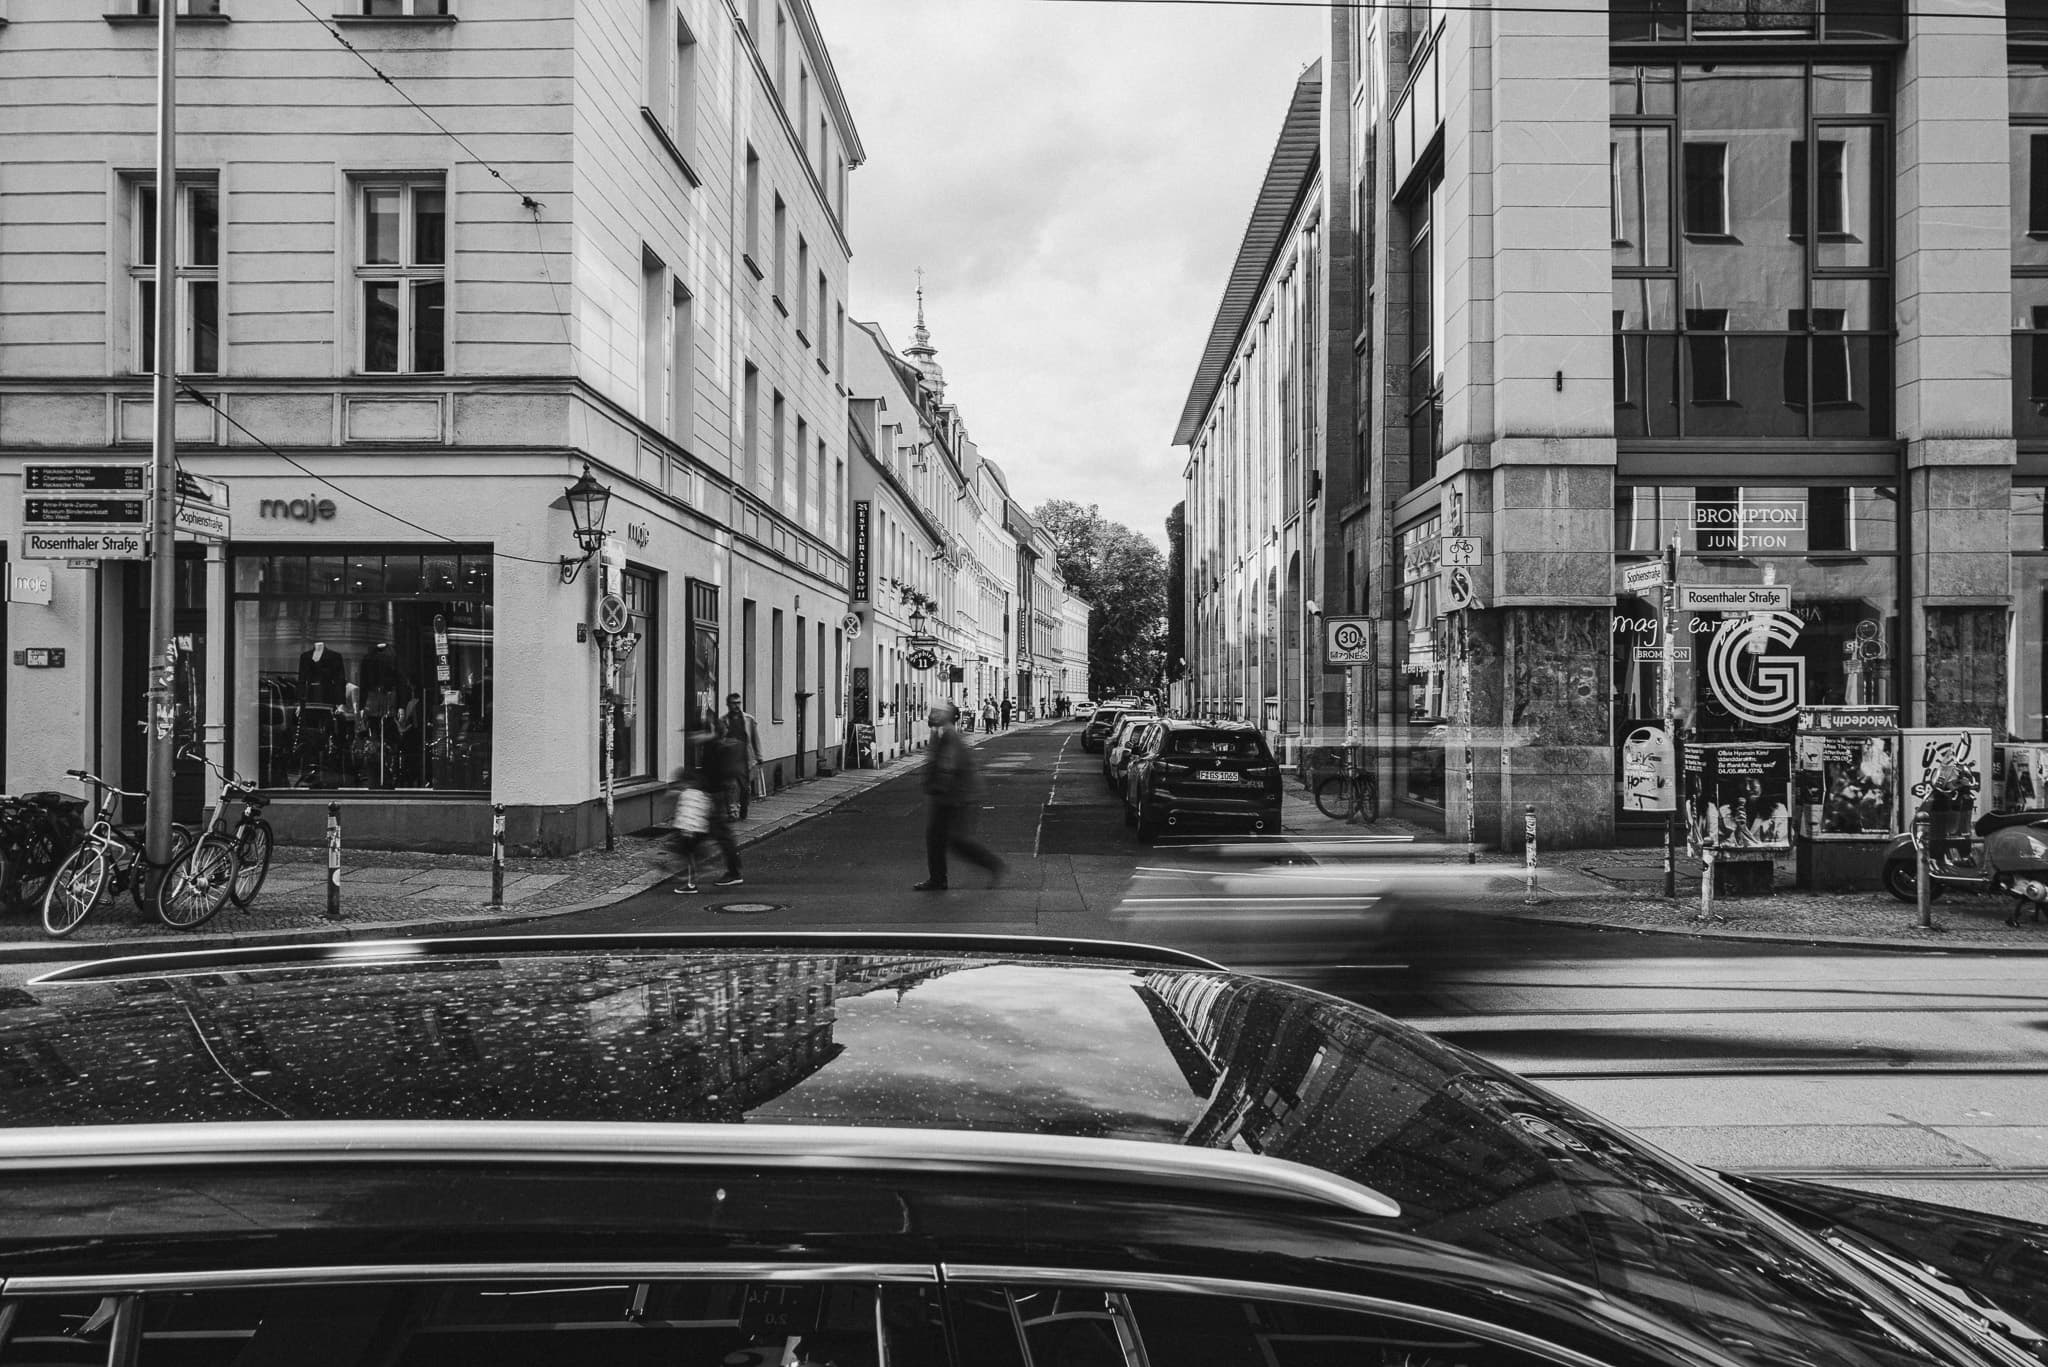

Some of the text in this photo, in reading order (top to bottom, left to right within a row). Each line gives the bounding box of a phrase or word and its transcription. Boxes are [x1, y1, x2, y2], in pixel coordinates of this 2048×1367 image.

[260, 493, 336, 525] maje
[1696, 508, 1797, 523] BROMPTON
[32, 536, 138, 553] Rosenthaler Straße
[857, 503, 868, 584] RESTAURATION
[1707, 536, 1787, 547] JUNCTION
[1688, 592, 1780, 605] Rosenthaler Straße
[1612, 615, 1679, 646] mag
[1341, 631, 1357, 644] 30
[1637, 651, 1687, 659] BROMON
[919, 659, 928, 668] 11
[1832, 715, 1893, 727] Velodeath
